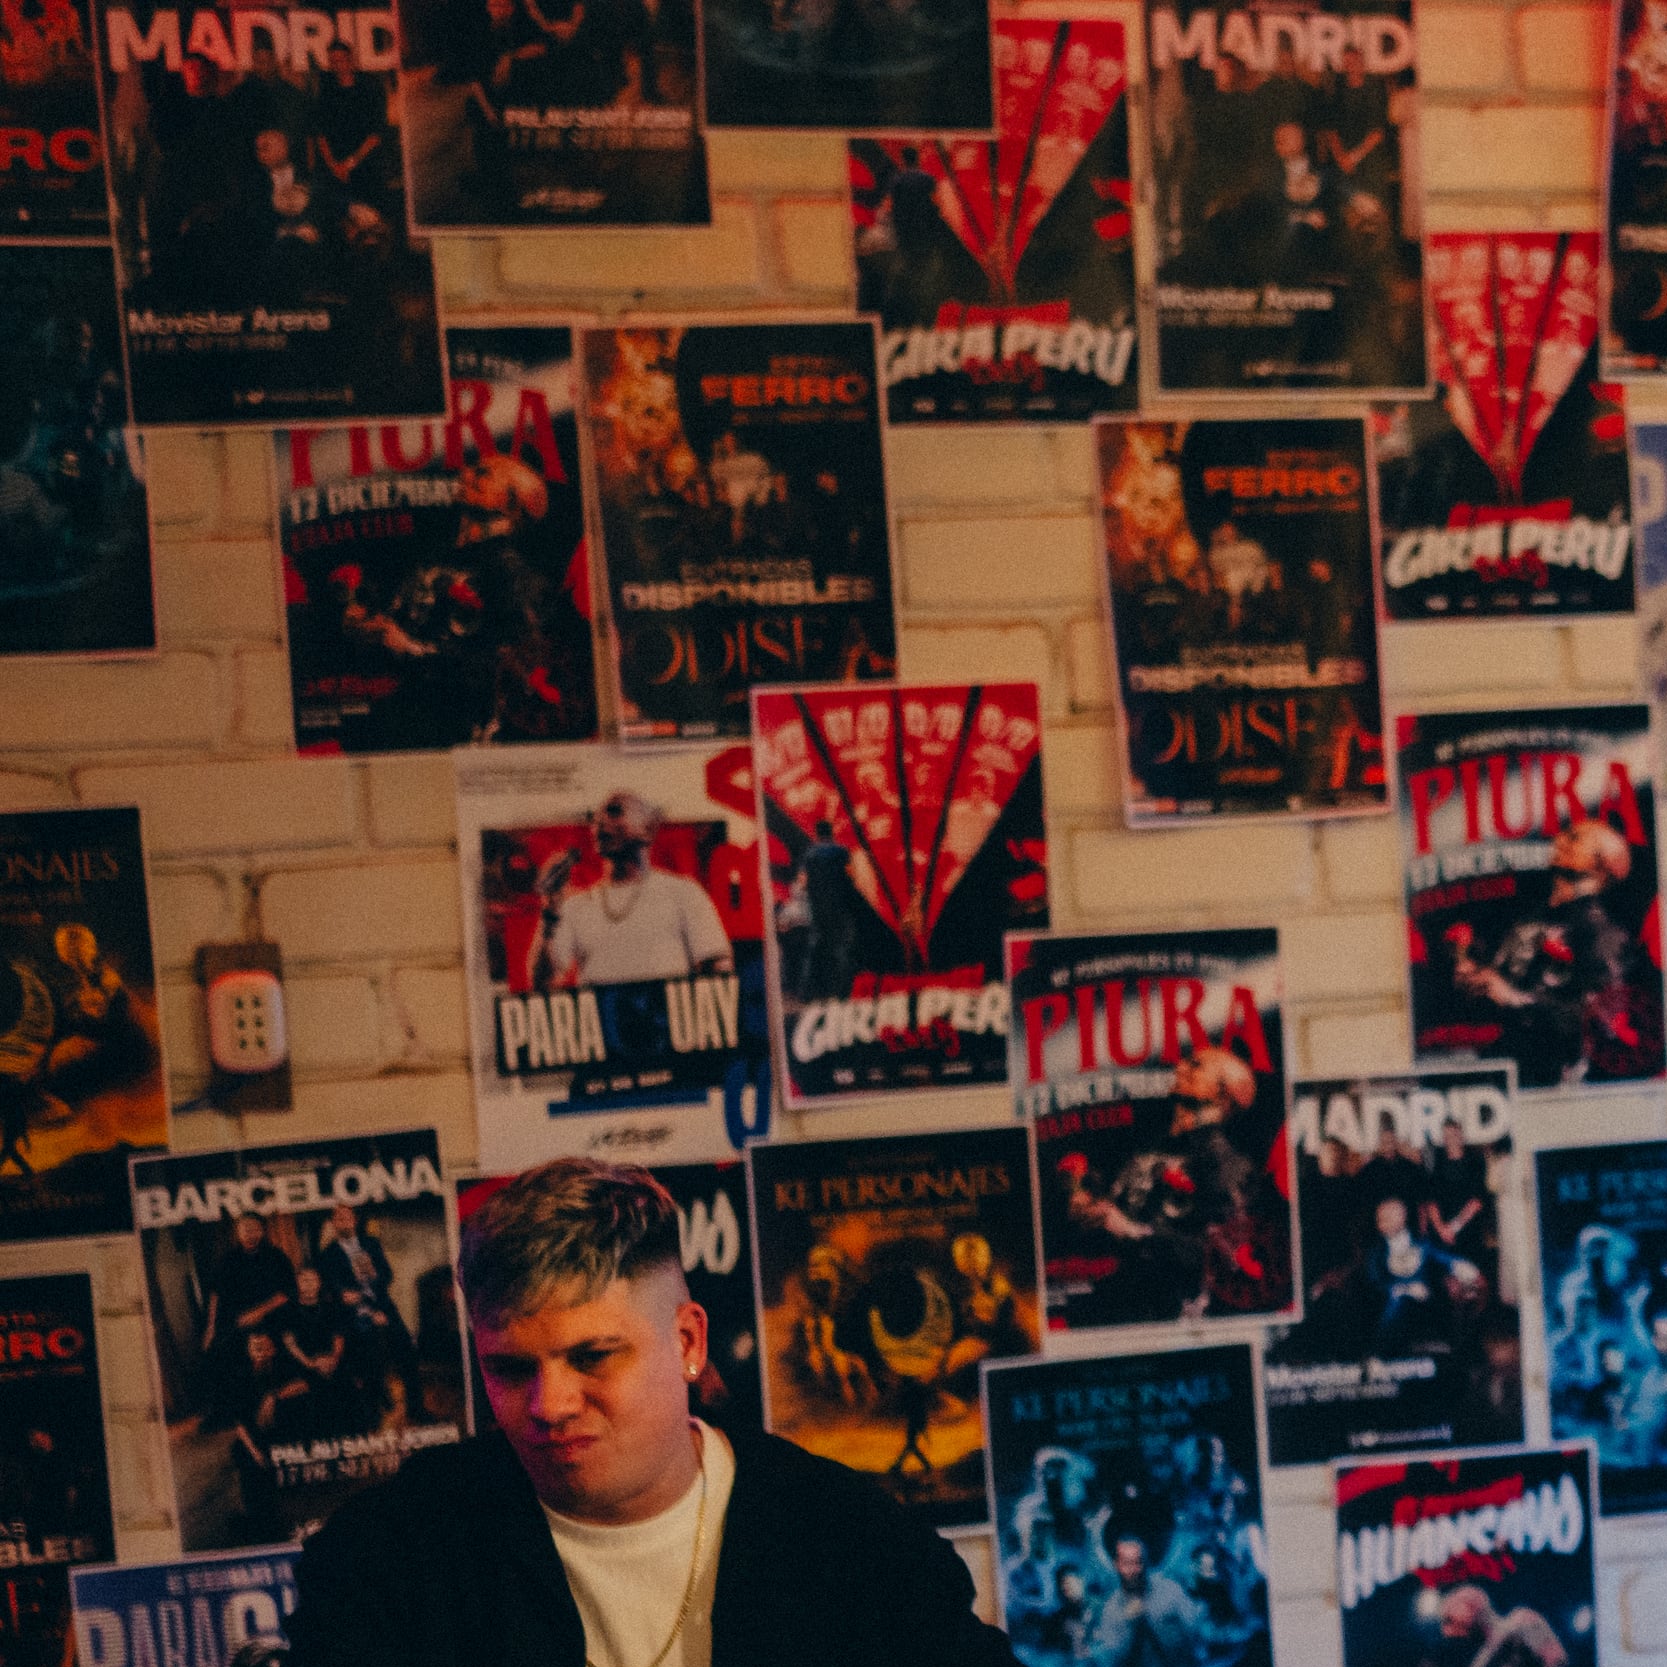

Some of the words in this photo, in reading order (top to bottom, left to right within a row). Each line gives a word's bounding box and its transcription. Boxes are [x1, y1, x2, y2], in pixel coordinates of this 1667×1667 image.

[105, 8, 400, 73] MADRID
[1150, 10, 1414, 75] MADRID
[128, 307, 245, 335] Movistar
[251, 305, 332, 331] Arena
[702, 372, 868, 407] FERRO
[1203, 466, 1361, 497] FERRO
[621, 575, 877, 611] DISPONIBLES
[1407, 750, 1649, 856] PIURA
[791, 990, 910, 1063] GIRA
[916, 978, 1011, 1037] PER
[1021, 976, 1276, 1086] PIURA
[135, 1155, 444, 1231] BARCELONA
[820, 1162, 1013, 1210] PERSONAJES
